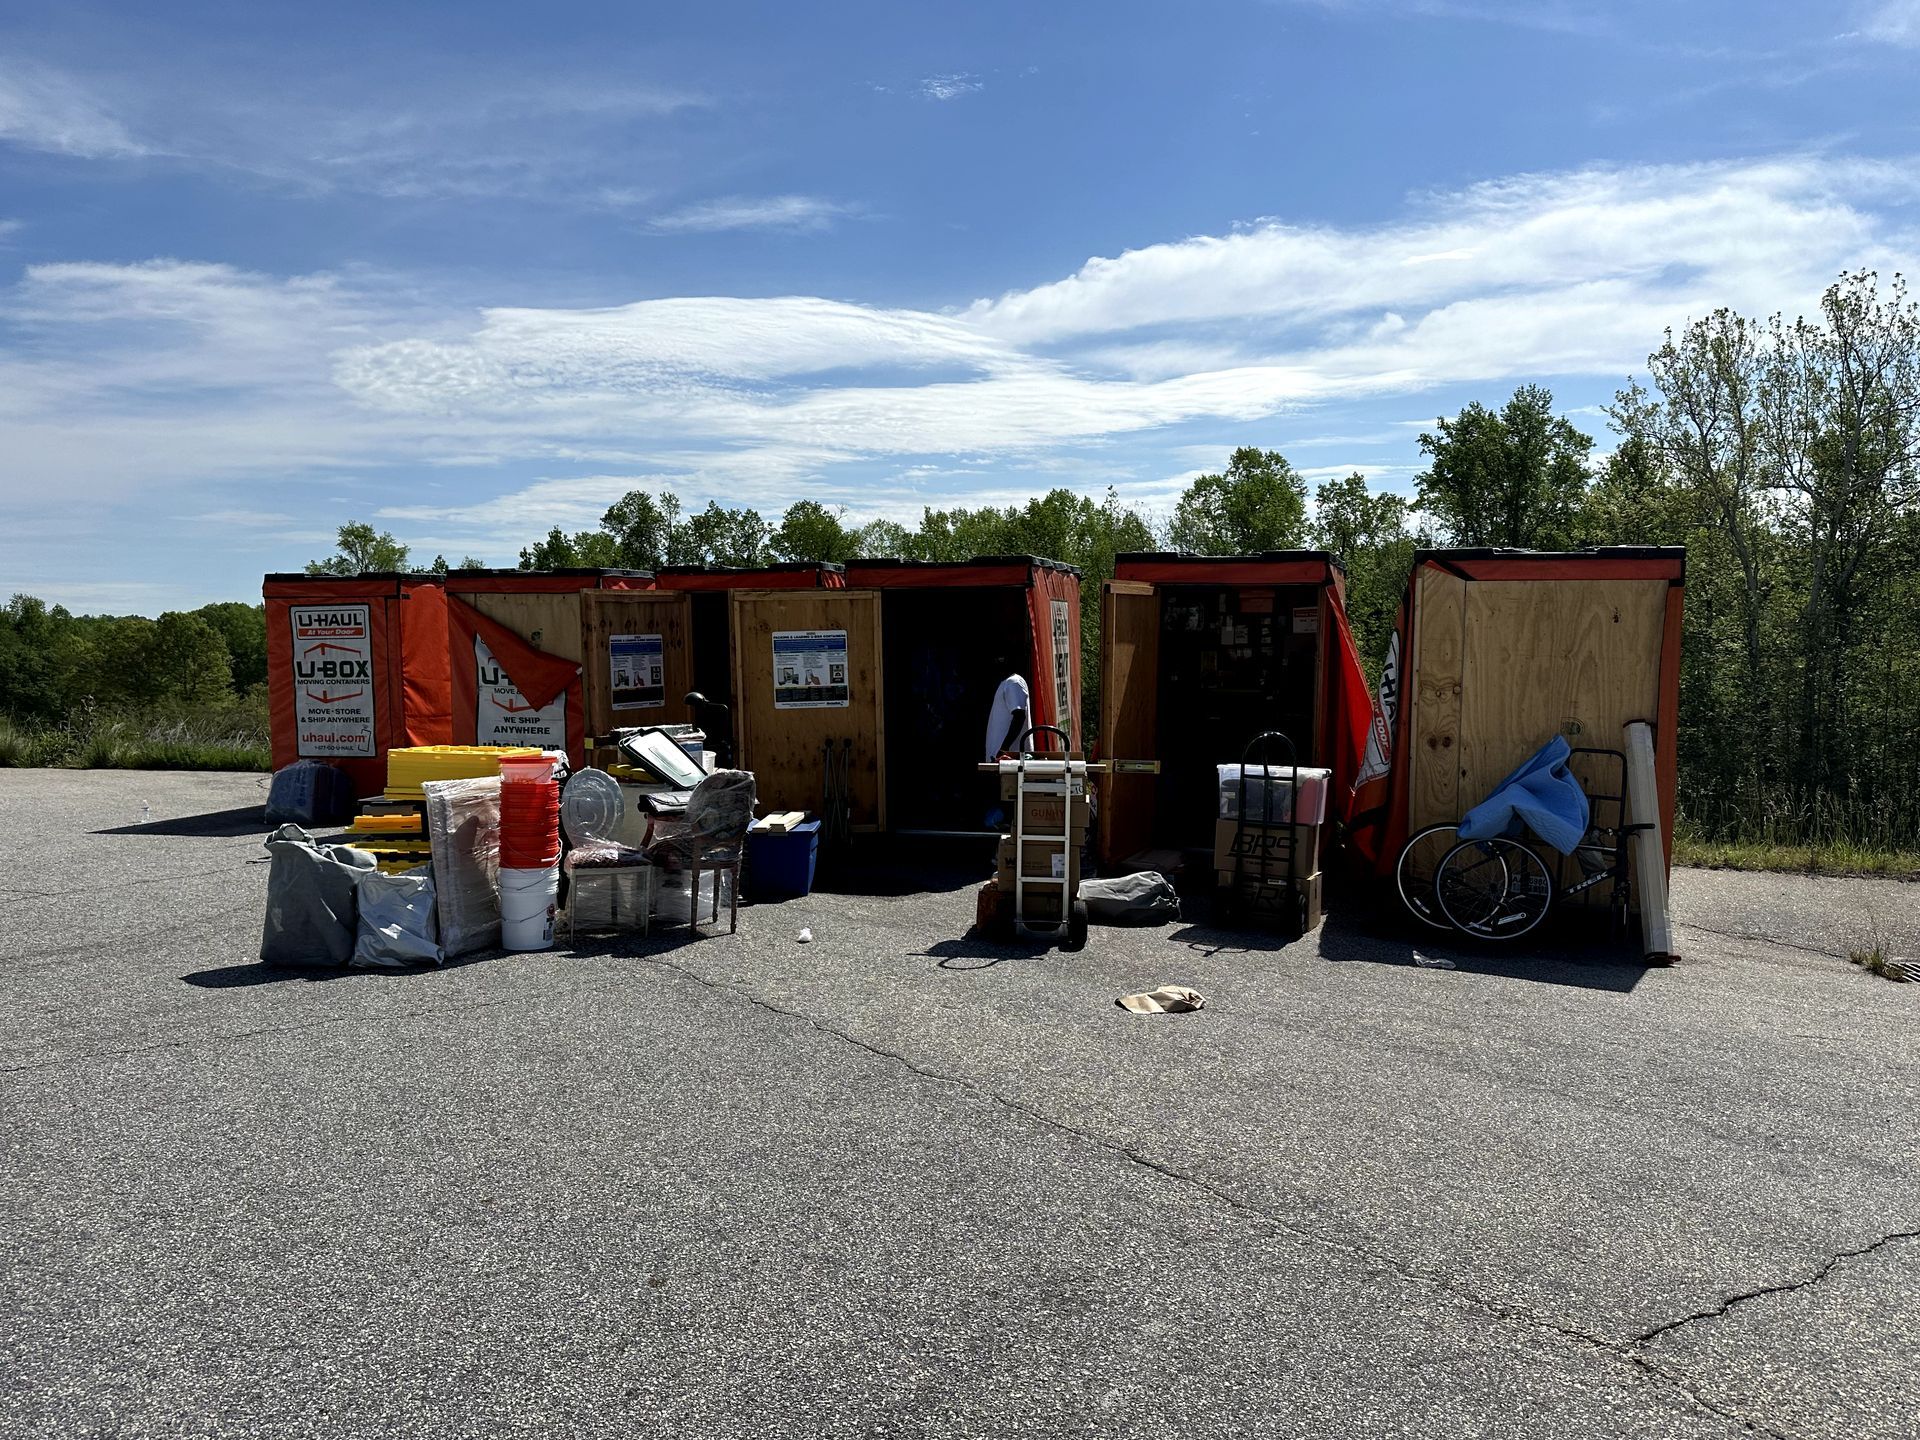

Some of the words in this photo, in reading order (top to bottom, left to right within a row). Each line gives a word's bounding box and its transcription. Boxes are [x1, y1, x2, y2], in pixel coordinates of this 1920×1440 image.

[298, 613, 362, 627] U-HAUL
[296, 660, 370, 678] U-BOX
[494, 726, 551, 734] ANYWHERE
[302, 732, 366, 742] uhaul.com
